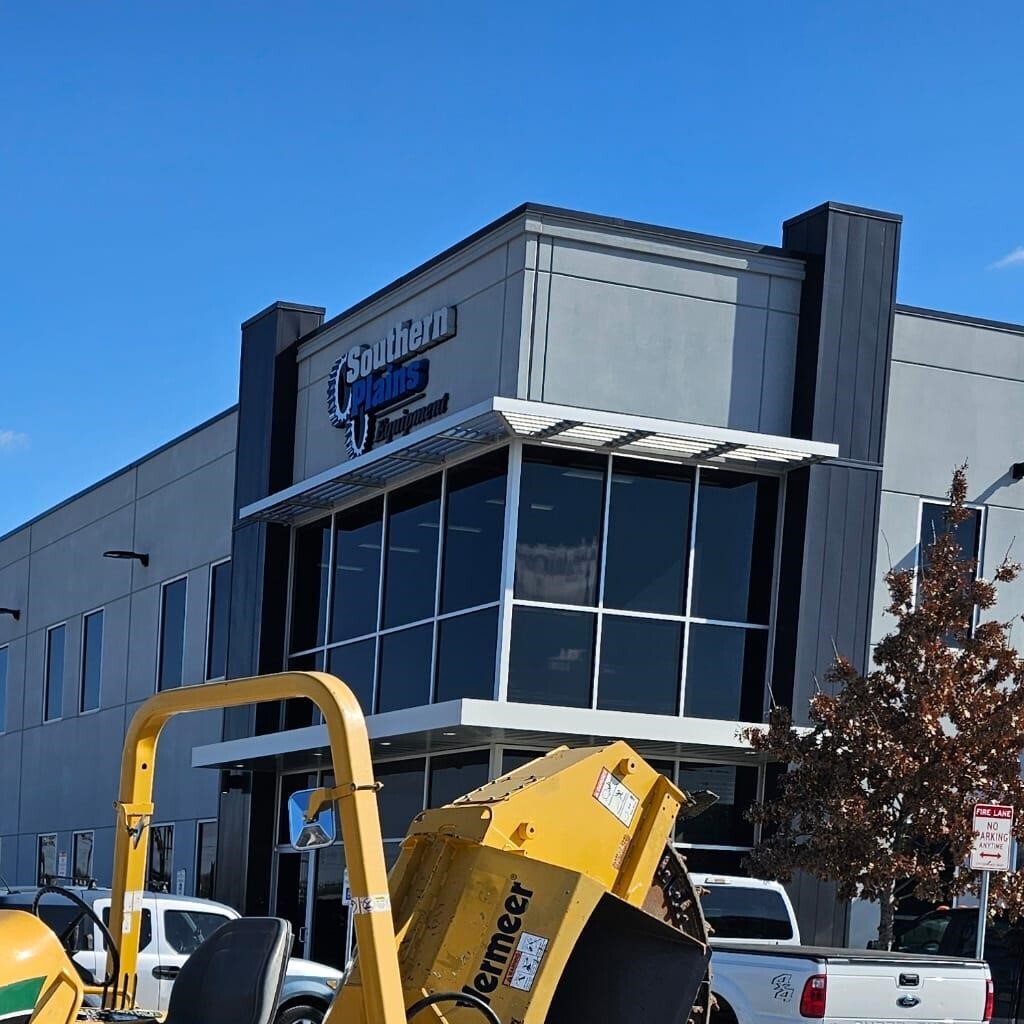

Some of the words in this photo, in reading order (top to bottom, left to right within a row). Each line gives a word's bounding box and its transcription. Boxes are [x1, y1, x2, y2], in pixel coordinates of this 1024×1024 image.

[346, 306, 450, 384] Southern
[351, 361, 424, 417] Plains
[375, 394, 450, 444] Equipment
[976, 808, 992, 817] FIRE
[993, 809, 1012, 818] LANE
[986, 821, 999, 831] NO
[979, 842, 1004, 850] ANYTIME
[455, 881, 534, 1009] Vermeer
